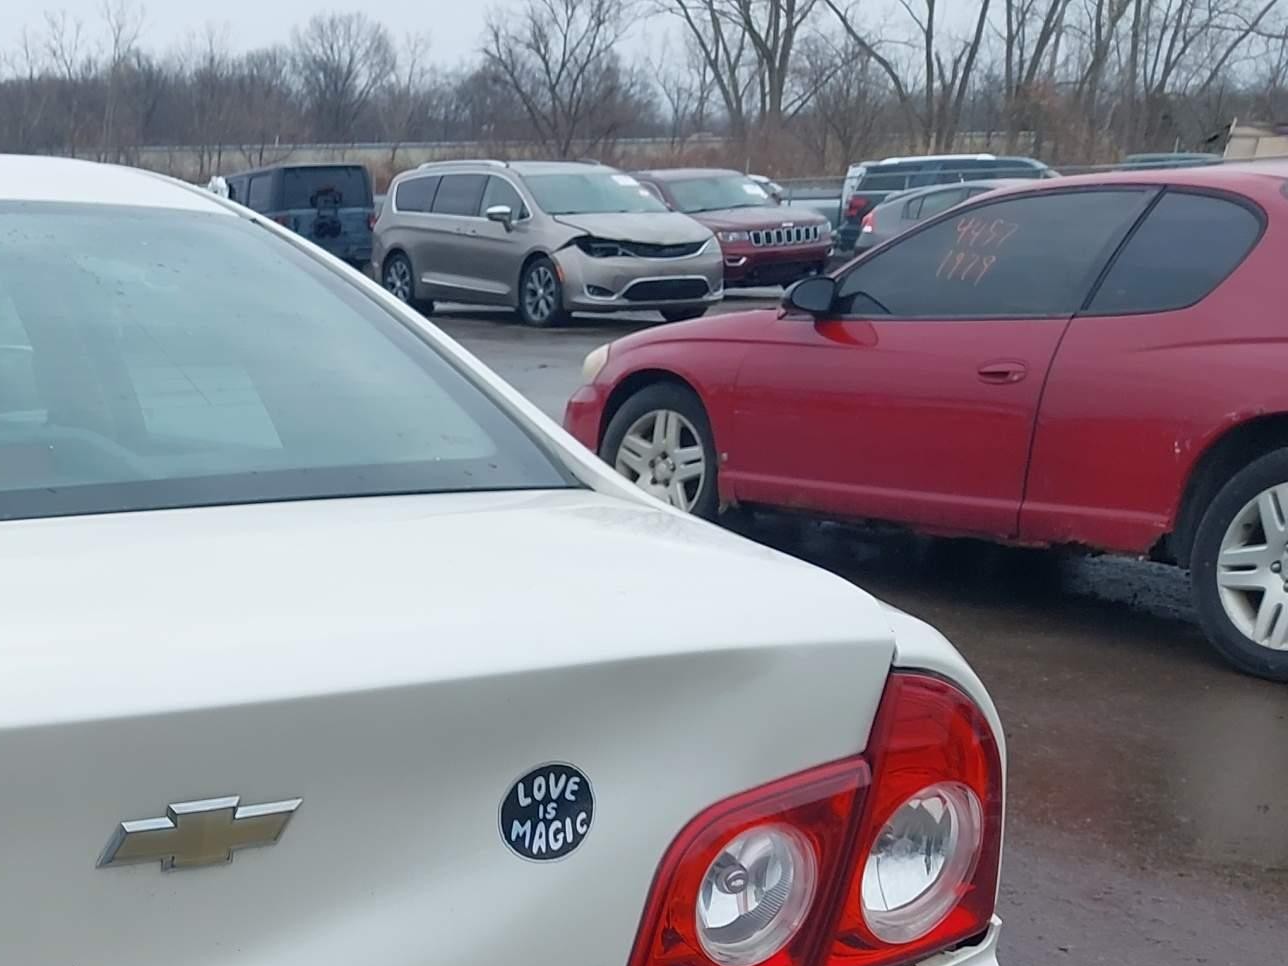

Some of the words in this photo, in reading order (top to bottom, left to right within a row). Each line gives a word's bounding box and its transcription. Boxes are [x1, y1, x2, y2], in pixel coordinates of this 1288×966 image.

[517, 771, 581, 807] LOVE
[538, 801, 558, 820] IS
[511, 811, 588, 855] MAGIC
